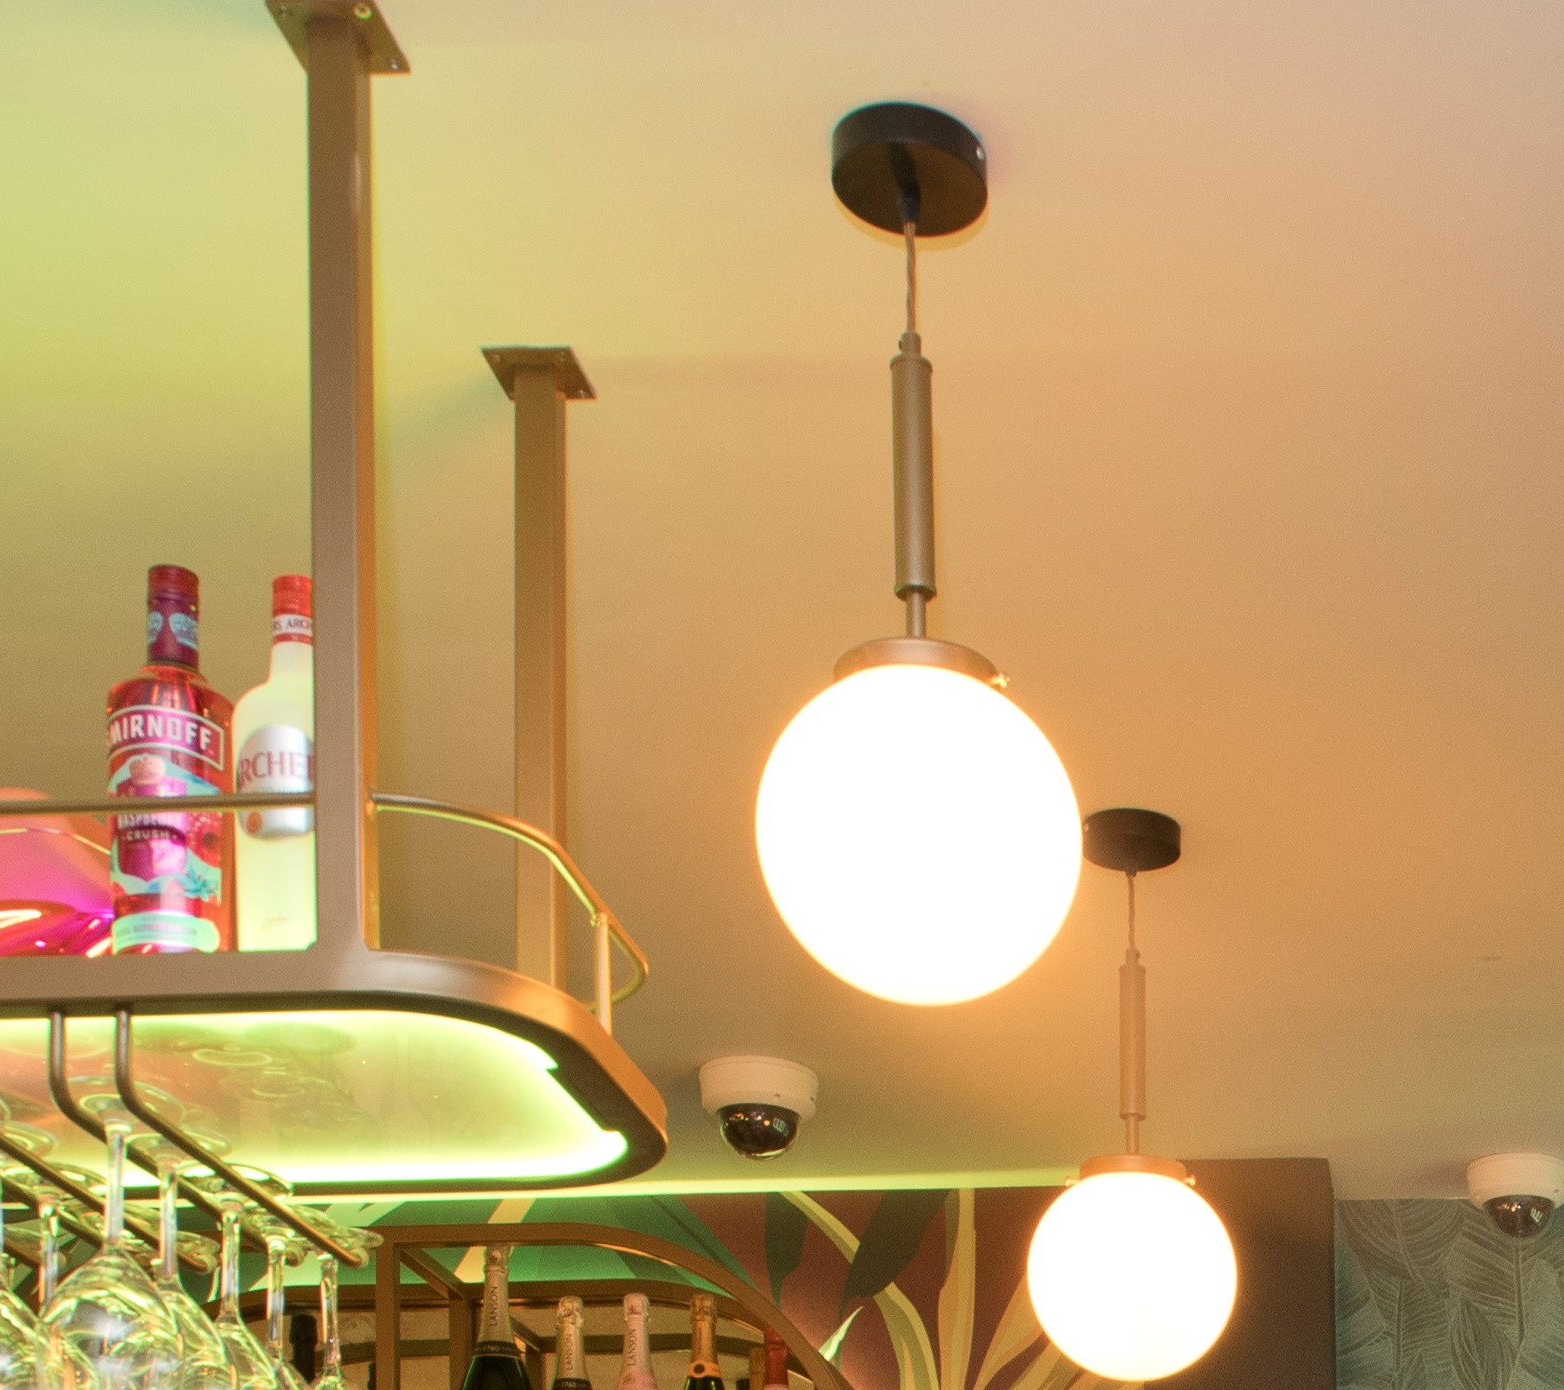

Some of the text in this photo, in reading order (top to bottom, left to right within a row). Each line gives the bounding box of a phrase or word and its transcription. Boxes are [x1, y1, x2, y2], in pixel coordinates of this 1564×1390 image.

[107, 712, 213, 752] MIRNOFF
[489, 1286, 498, 1327] LANSON
[565, 1333, 574, 1371] LANSON
[627, 1328, 637, 1366] LANSON
